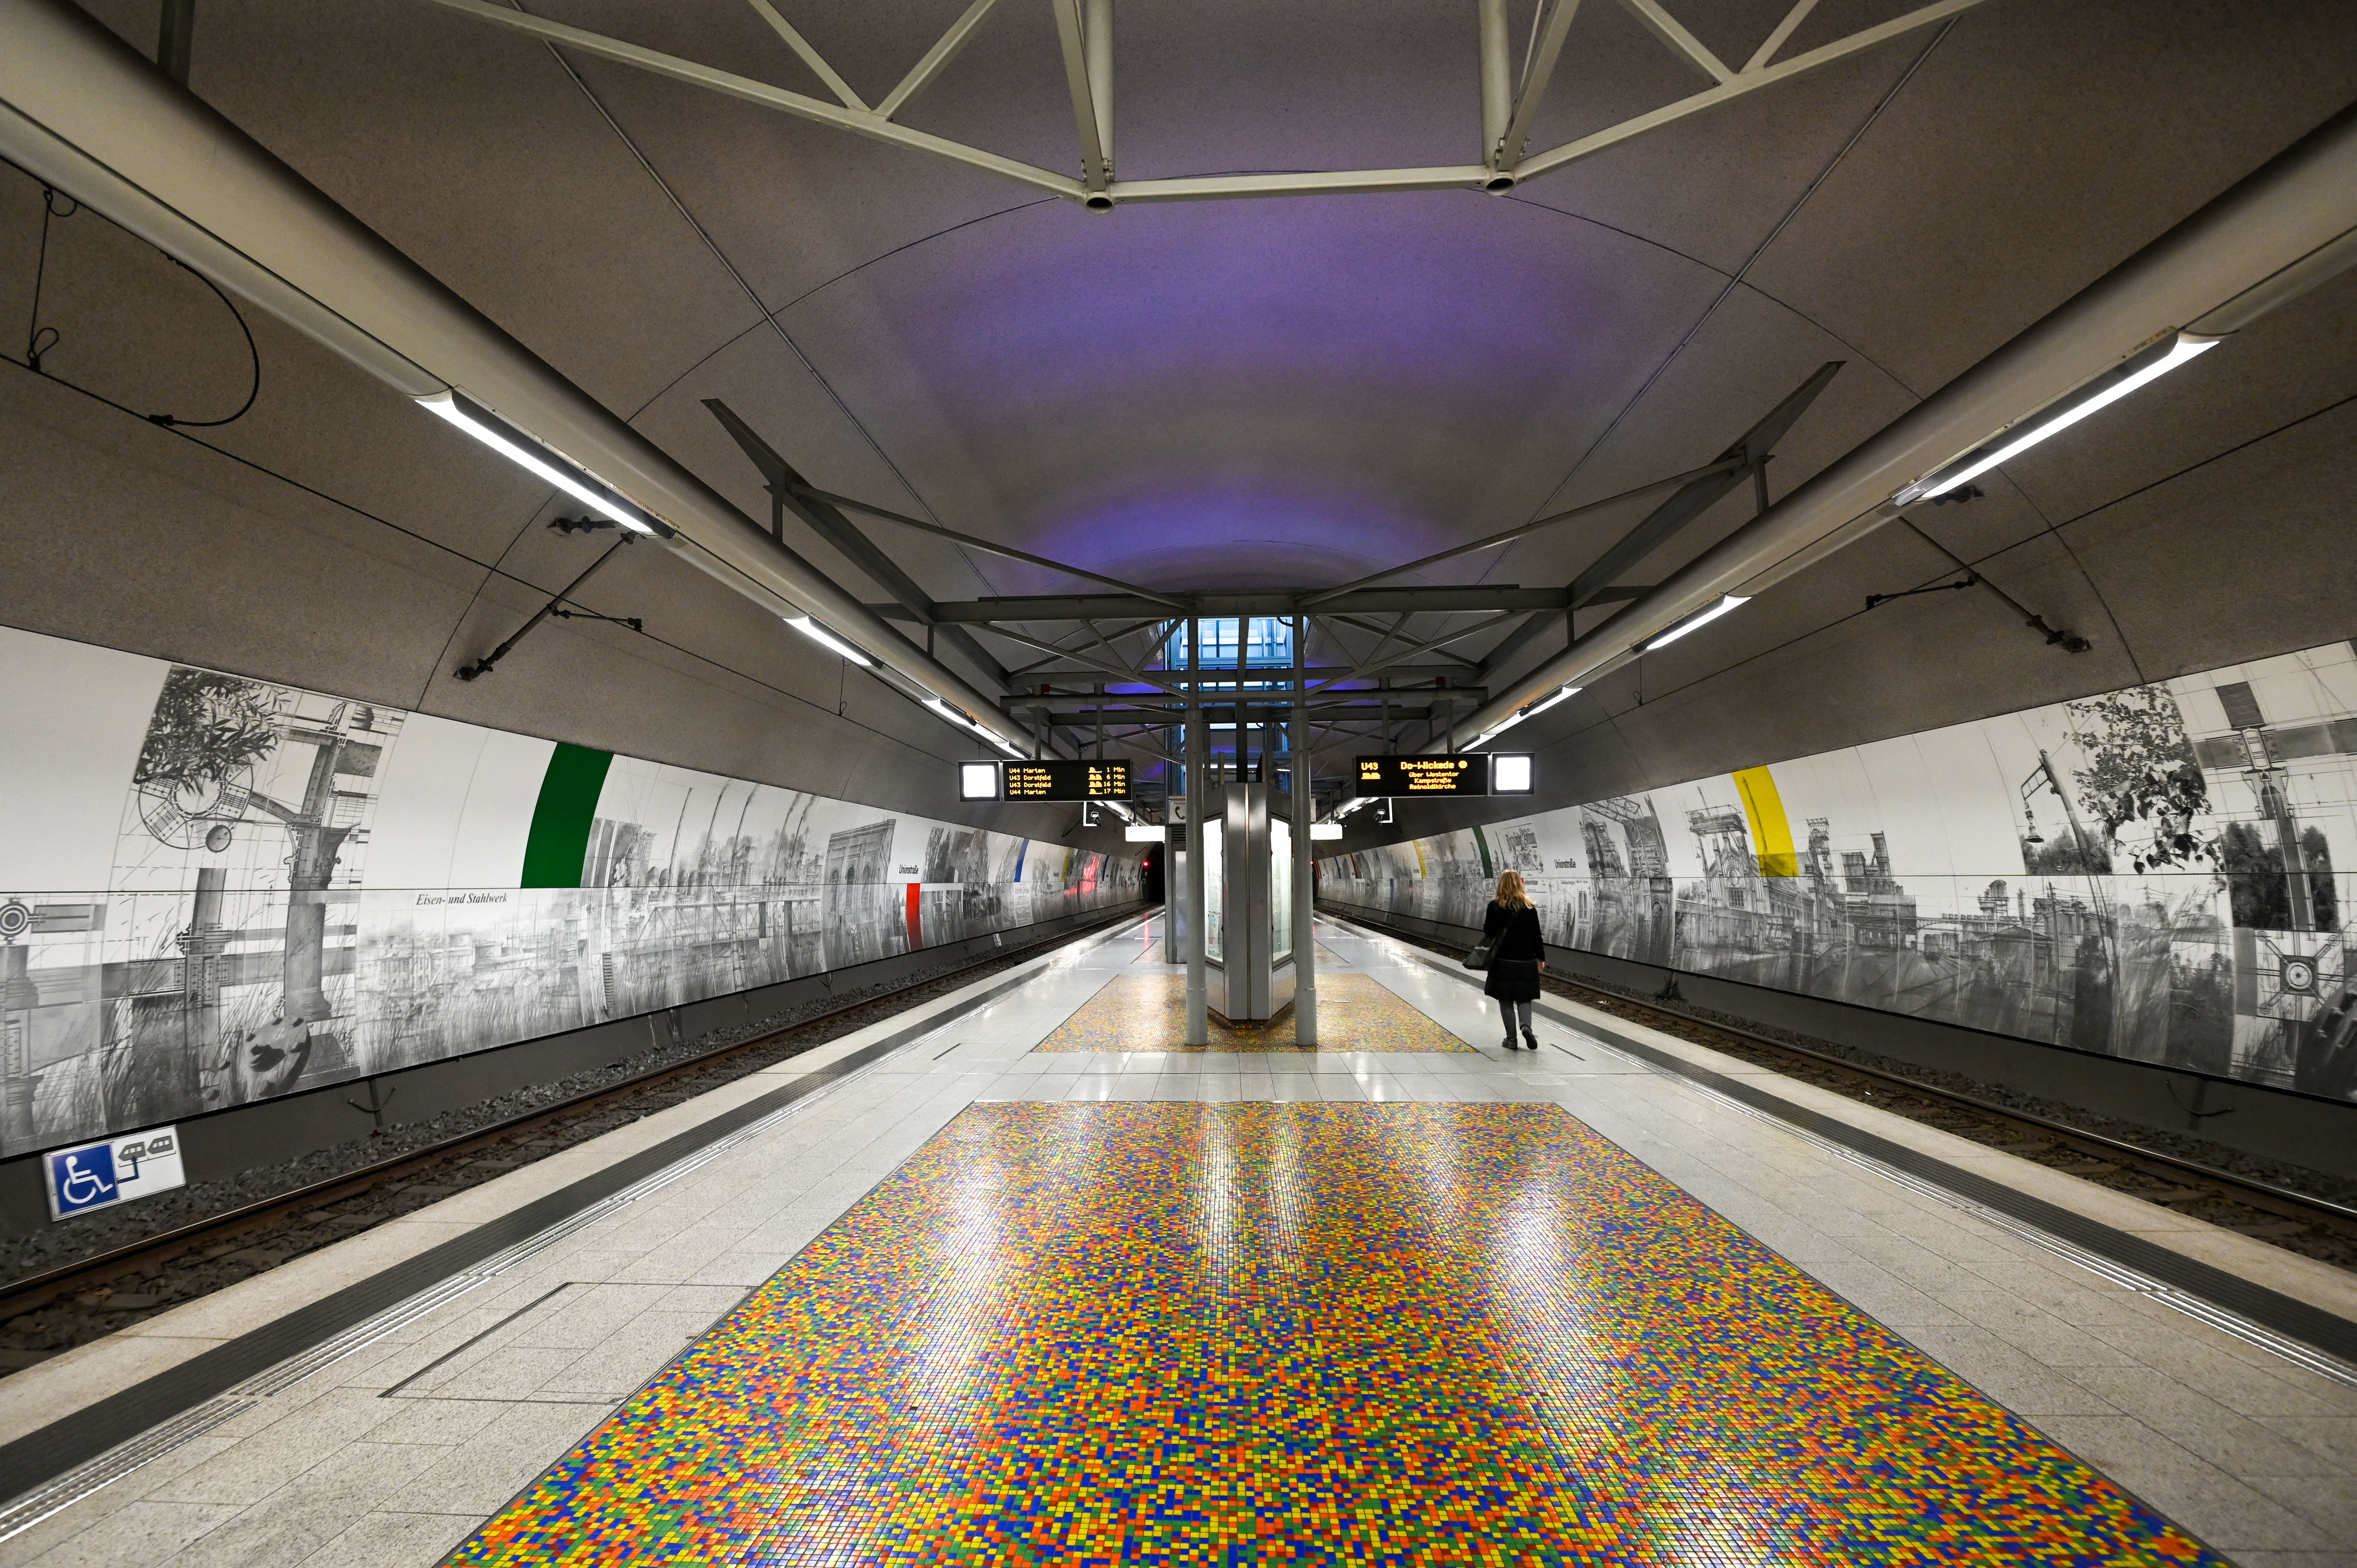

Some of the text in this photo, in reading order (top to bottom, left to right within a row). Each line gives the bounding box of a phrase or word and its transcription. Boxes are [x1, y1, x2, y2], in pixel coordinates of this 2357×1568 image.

[1361, 762, 1378, 770] U43
[1400, 761, 1455, 770] Do-Wickede
[1554, 858, 1576, 869] Unionstraße
[899, 864, 919, 874] Unionstraße
[416, 893, 508, 905] Eisen- und Stahlwerk
